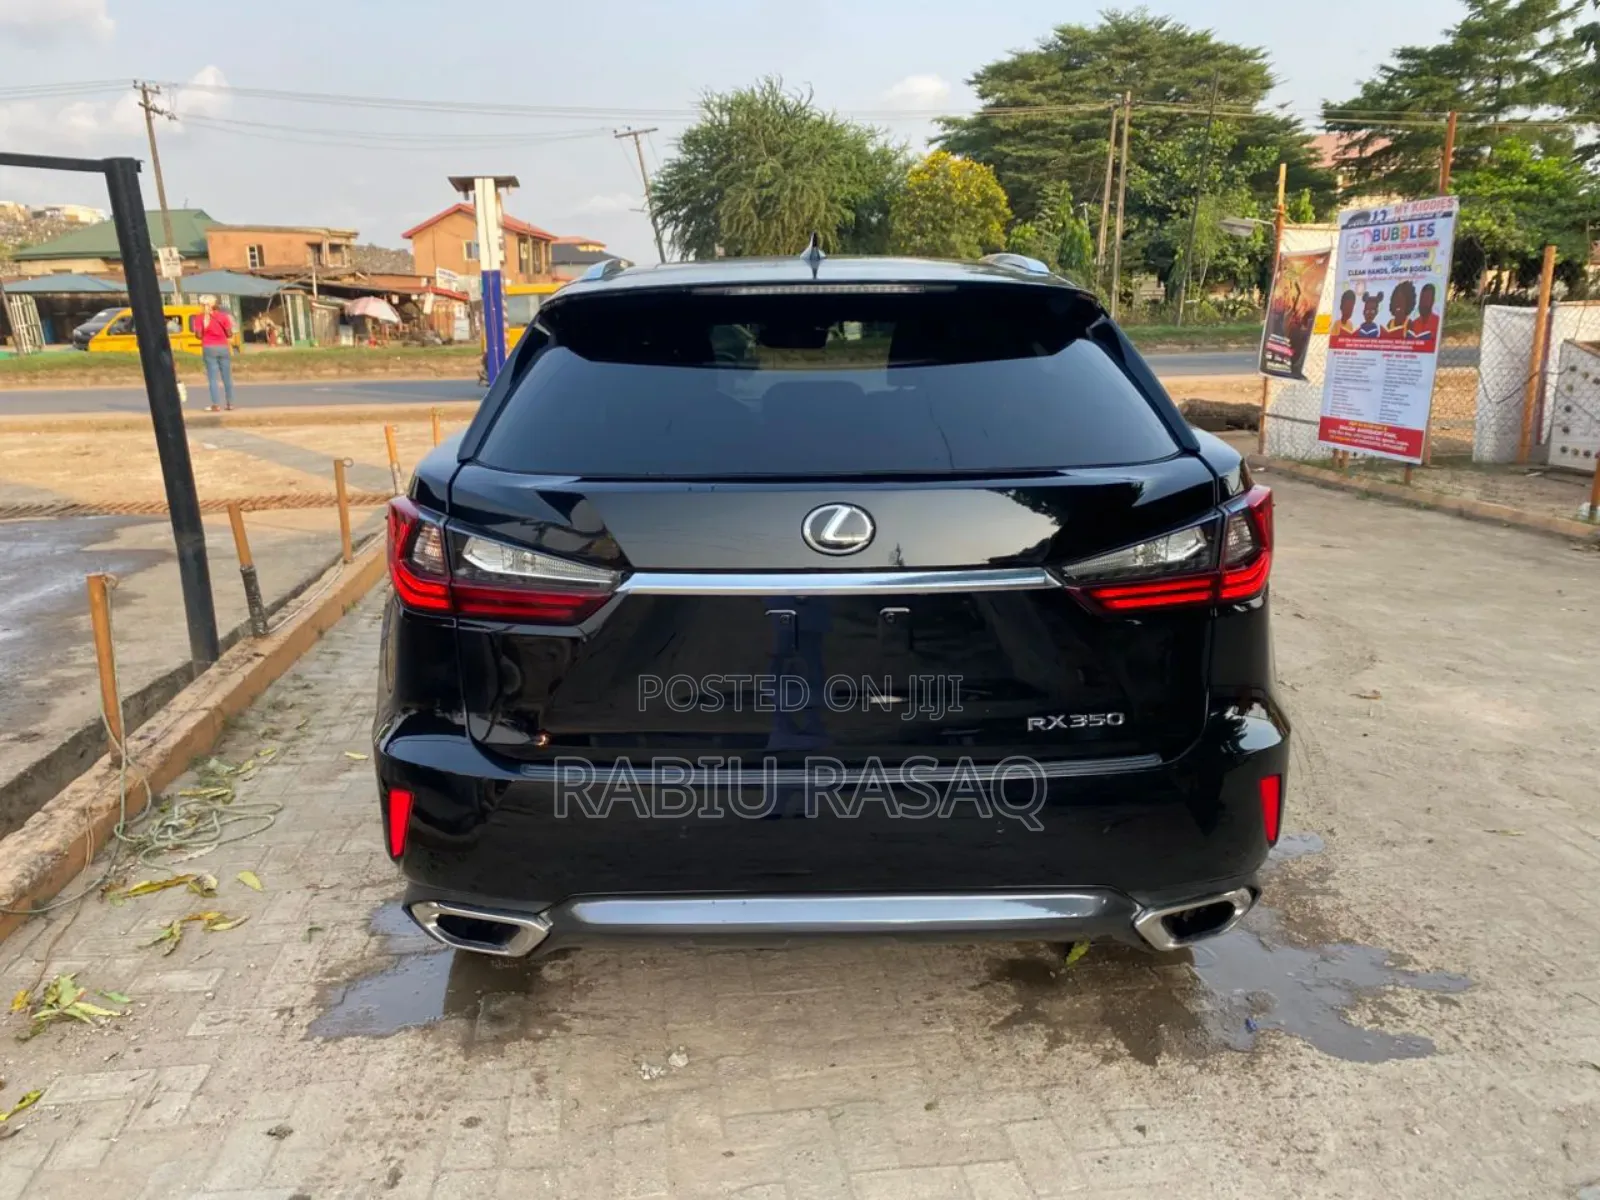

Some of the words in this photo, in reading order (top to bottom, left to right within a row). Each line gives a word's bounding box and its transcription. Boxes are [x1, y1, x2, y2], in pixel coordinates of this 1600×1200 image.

[1372, 223, 1435, 242] BUBBLES
[1391, 266, 1408, 274] OPEN
[1409, 264, 1432, 273] BOOKS
